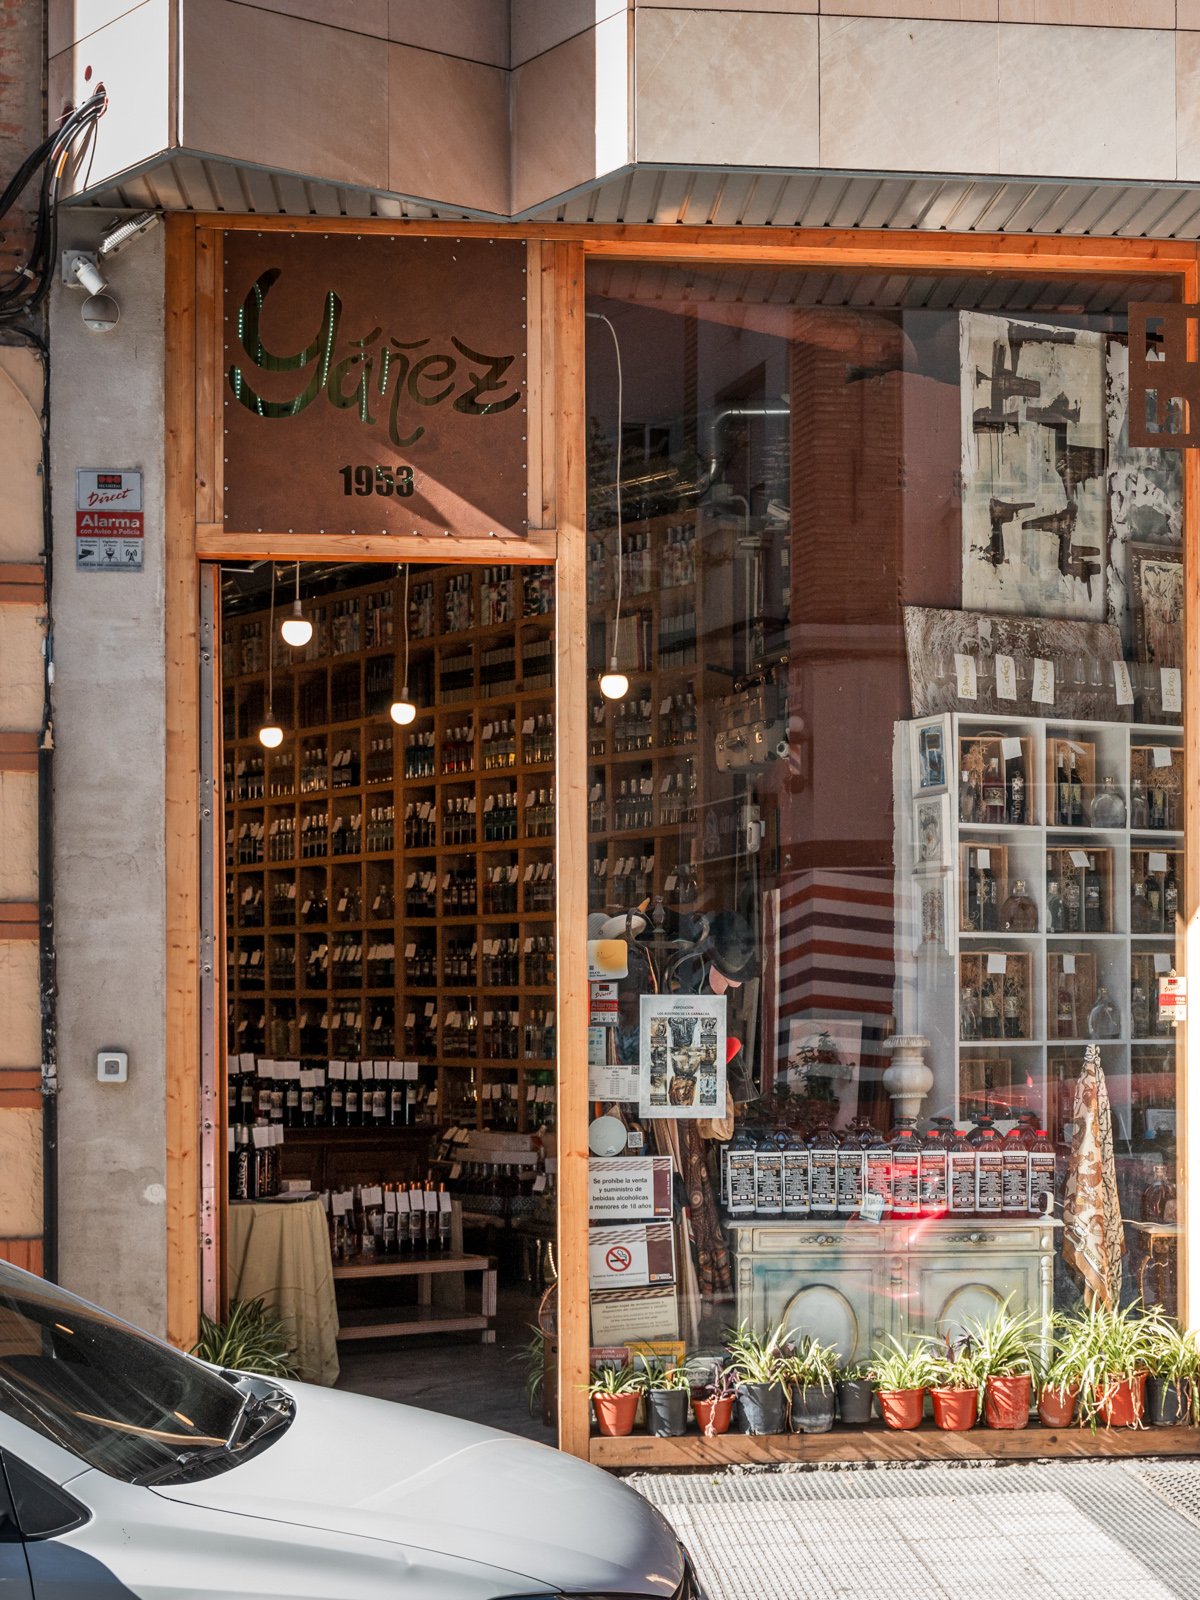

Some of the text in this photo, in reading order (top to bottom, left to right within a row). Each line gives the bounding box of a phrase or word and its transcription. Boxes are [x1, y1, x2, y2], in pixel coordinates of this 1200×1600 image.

[229, 268, 521, 447] Yáñez
[1145, 316, 1199, 363] El
[1145, 389, 1191, 435] La
[87, 488, 134, 507] Direct
[338, 465, 414, 497] 1953
[81, 514, 140, 528] Alarma
